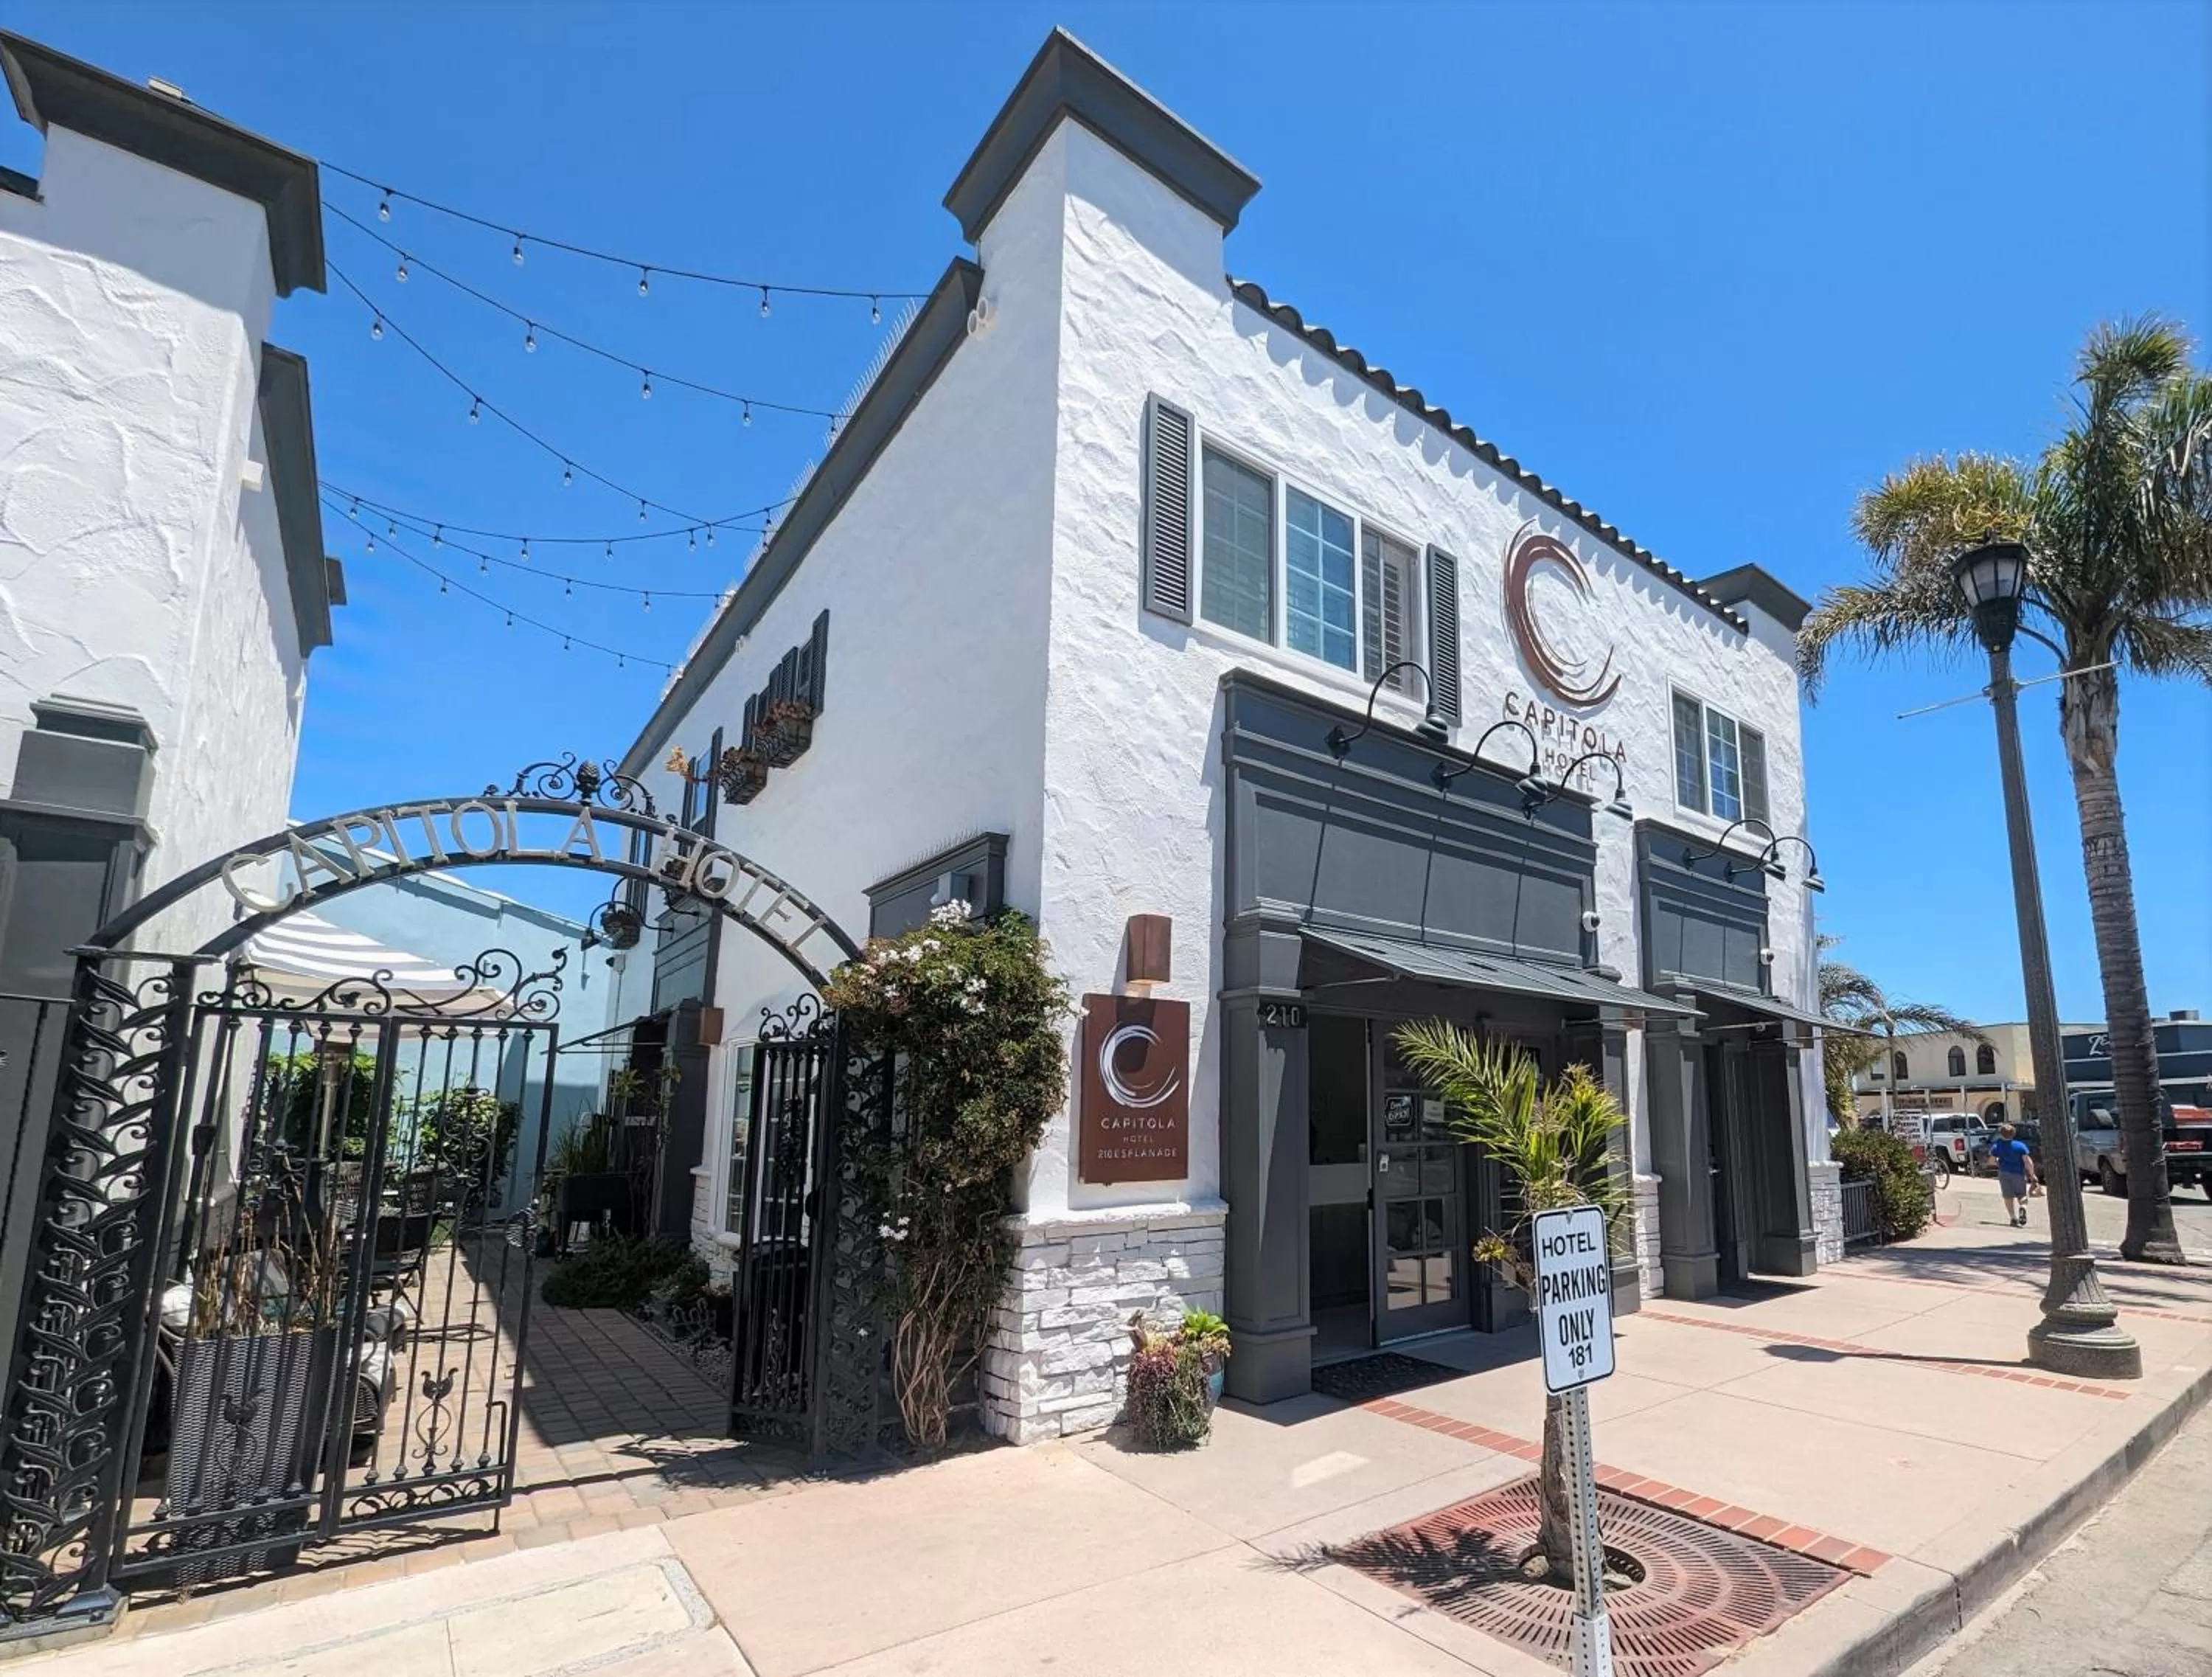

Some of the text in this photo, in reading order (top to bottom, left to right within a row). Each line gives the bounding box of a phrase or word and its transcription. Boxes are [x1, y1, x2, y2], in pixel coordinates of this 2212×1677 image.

[1505, 692, 1627, 763] CAPITOLA
[222, 799, 827, 959] CAPITOLA HOTEL
[1266, 1004, 1300, 1027] 210
[1101, 1117, 1176, 1130] CAPITOLA
[1542, 1232, 1597, 1259] HOTEL
[1542, 1263, 1607, 1306] PARKING
[1559, 1308, 1595, 1347] ONLY
[1568, 1342, 1593, 1369] 181
